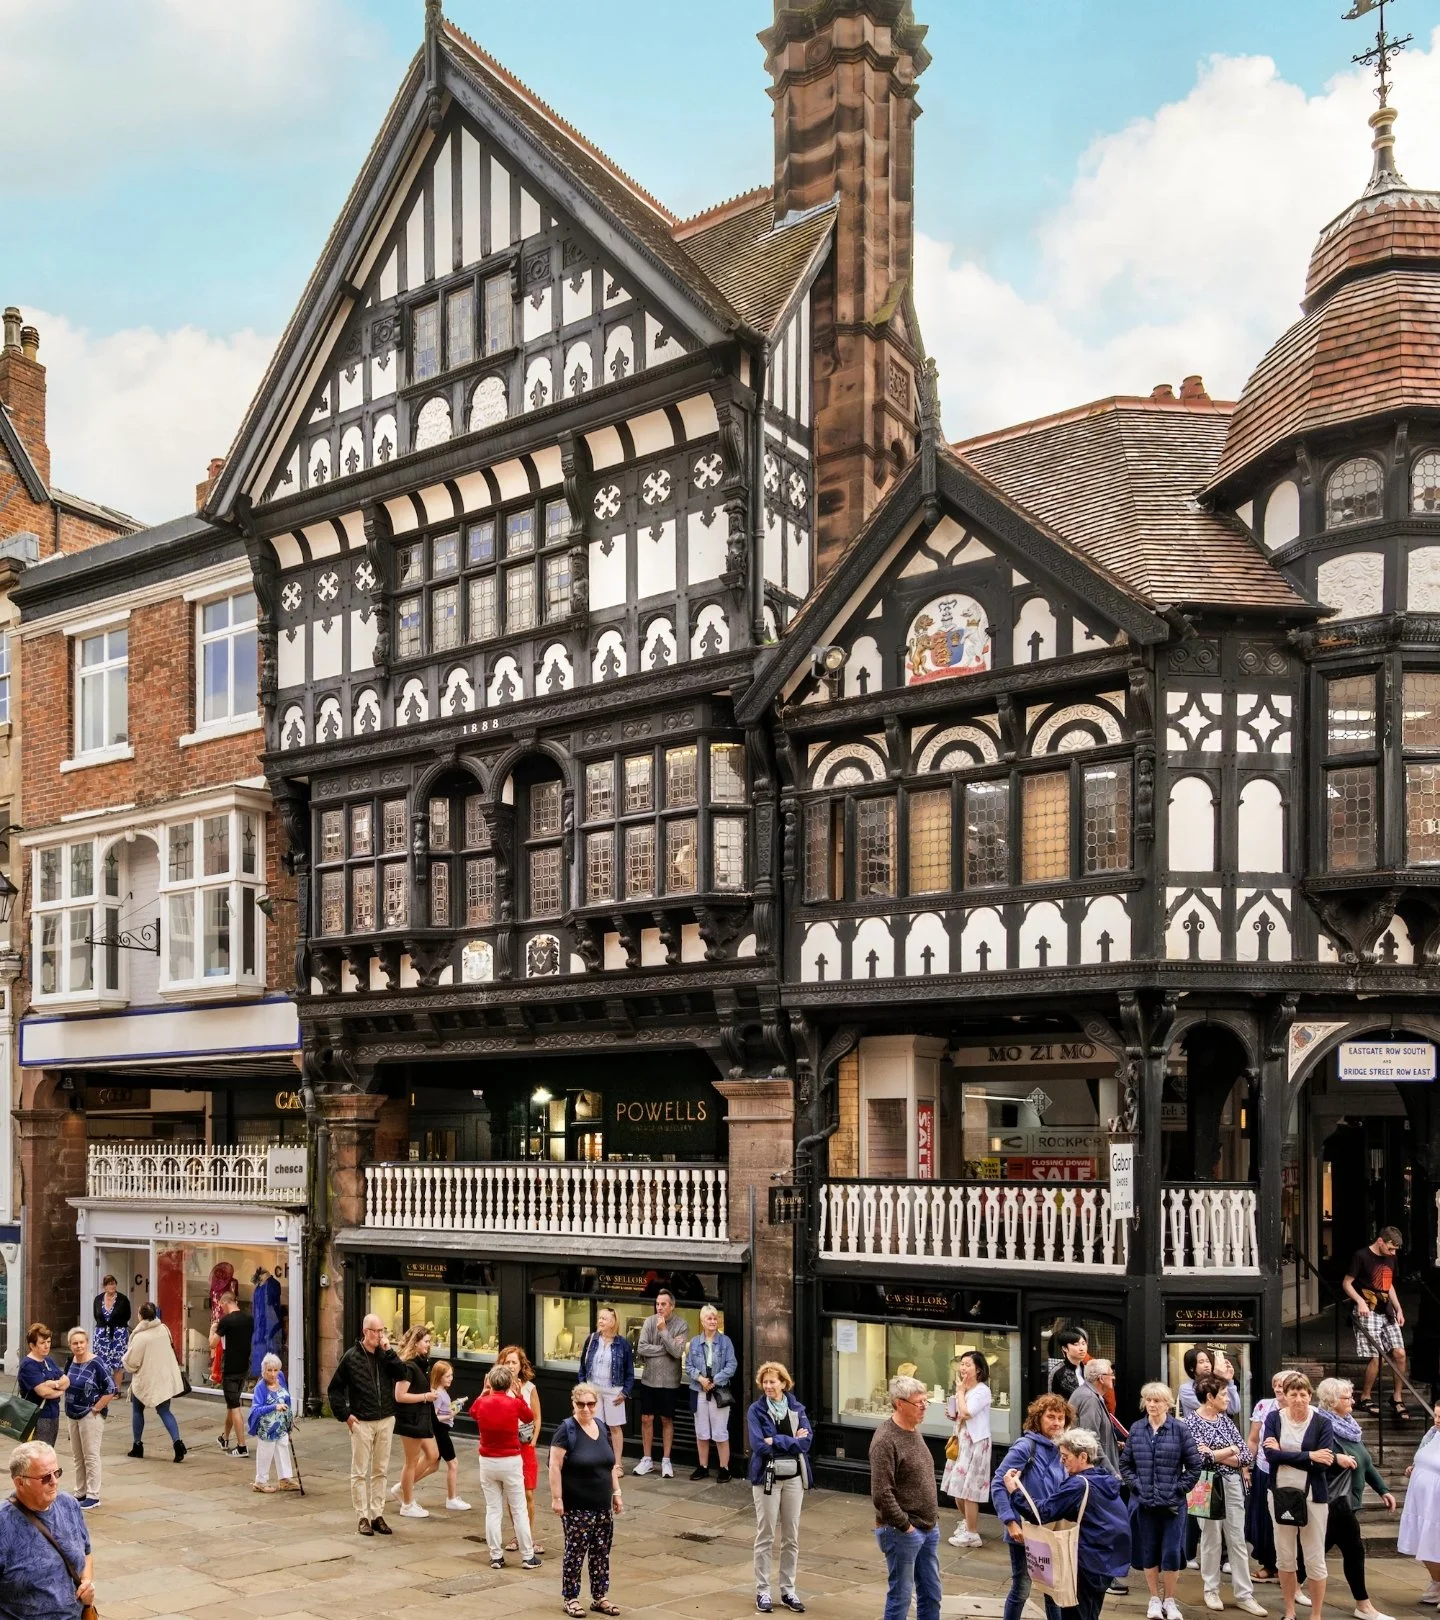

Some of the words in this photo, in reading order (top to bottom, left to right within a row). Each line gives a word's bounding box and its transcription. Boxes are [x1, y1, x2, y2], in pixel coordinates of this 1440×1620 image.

[463, 719, 499, 735] 1888
[988, 1046, 1022, 1062] MO
[1030, 1044, 1054, 1060] ZI
[1060, 1043, 1097, 1059] MO
[1348, 1047, 1383, 1055] EASTGATE
[1385, 1047, 1401, 1055] ROW
[1403, 1047, 1426, 1055] SOUTH
[1343, 1068, 1368, 1076] BRIDGE
[1369, 1068, 1394, 1076] STREET
[1396, 1068, 1412, 1076] ROW
[1413, 1068, 1431, 1076] EAST
[616, 1101, 707, 1121] POWELLS
[918, 1112, 928, 1179] SALE
[274, 1164, 304, 1174] chesca
[1112, 1153, 1132, 1172] Gabor
[1032, 1167, 1091, 1180] SALE
[154, 1216, 220, 1236] chesca
[1038, 1556, 1050, 1565] Hill
